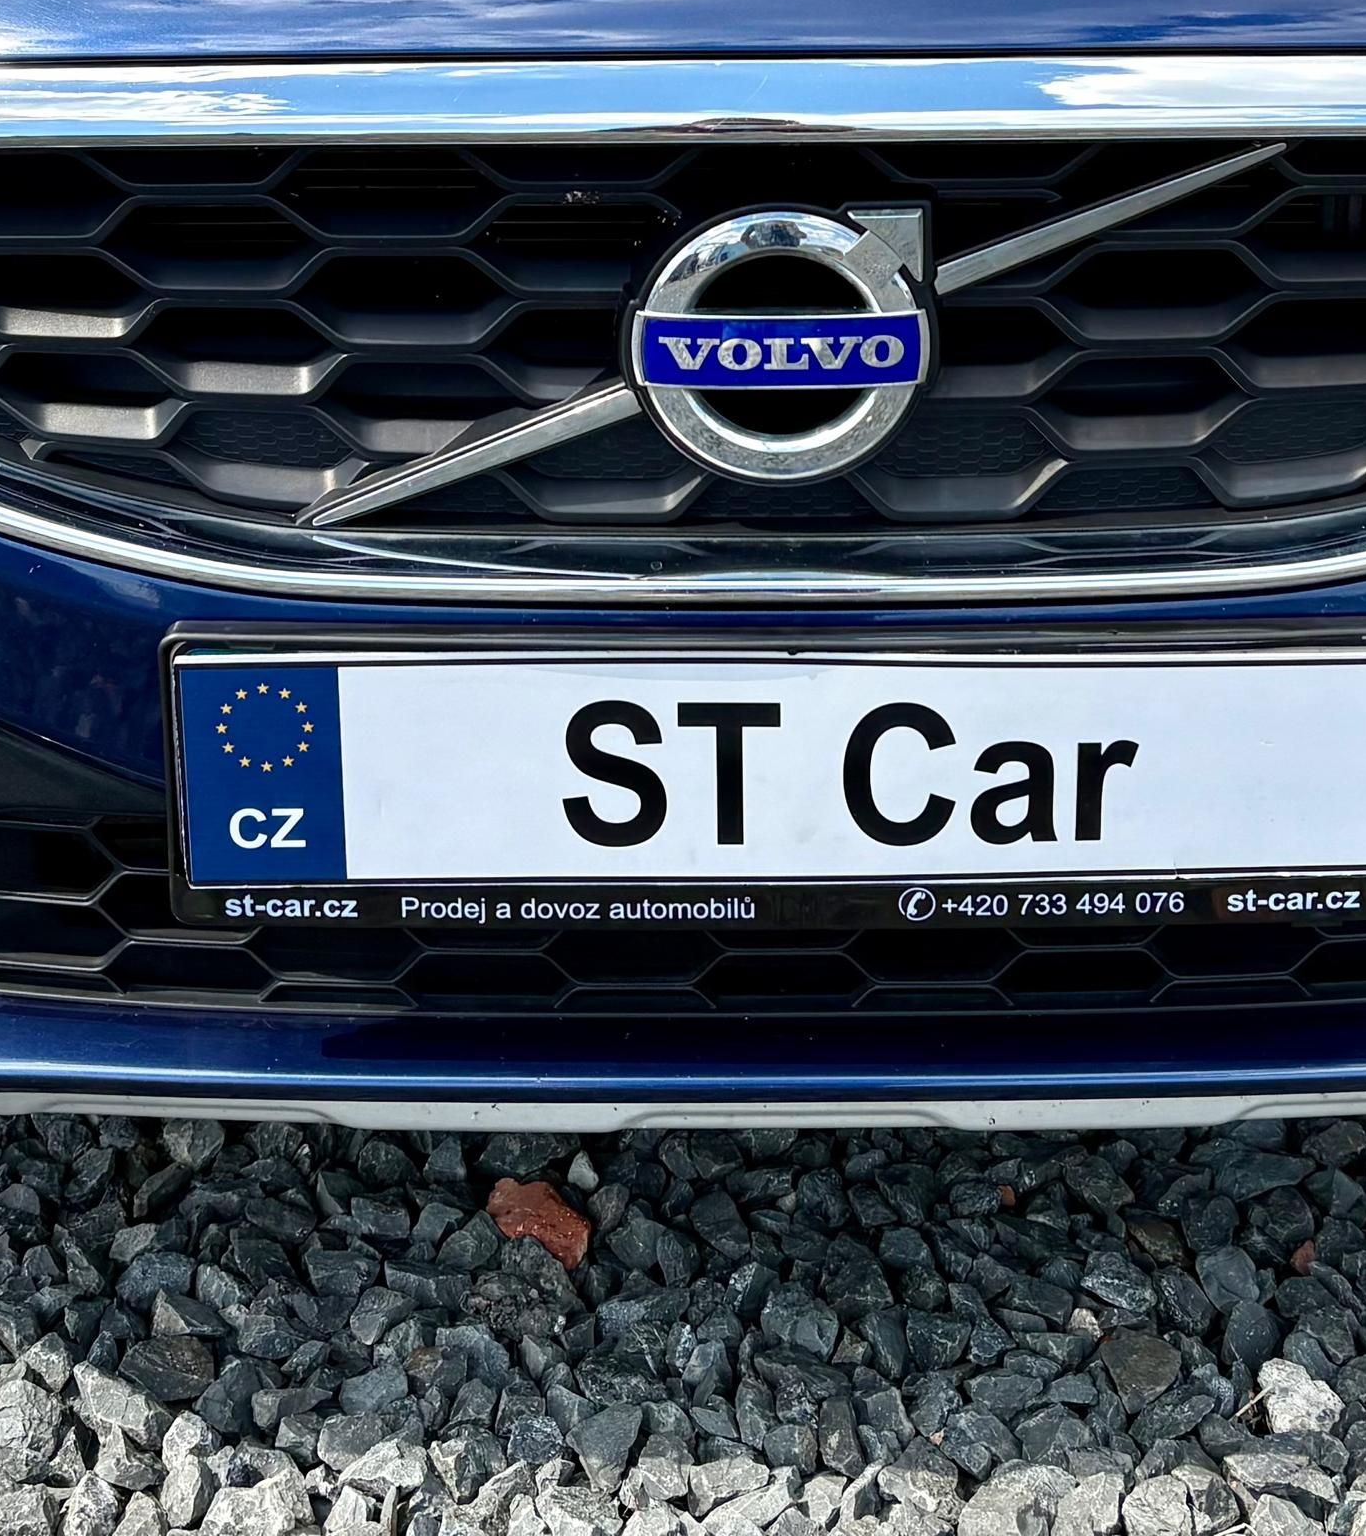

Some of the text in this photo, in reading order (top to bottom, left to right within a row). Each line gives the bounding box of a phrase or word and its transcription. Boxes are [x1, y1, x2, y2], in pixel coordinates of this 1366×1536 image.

[658, 334, 905, 371] VOLVO
[562, 699, 1140, 848] ST Car
[229, 807, 307, 849] CZ
[225, 894, 359, 919] st-car.cz
[401, 896, 755, 924] Prodej a dovoz automobilů
[941, 891, 1185, 916] +420 733 494 076
[1227, 889, 1361, 912] st-car.cz
